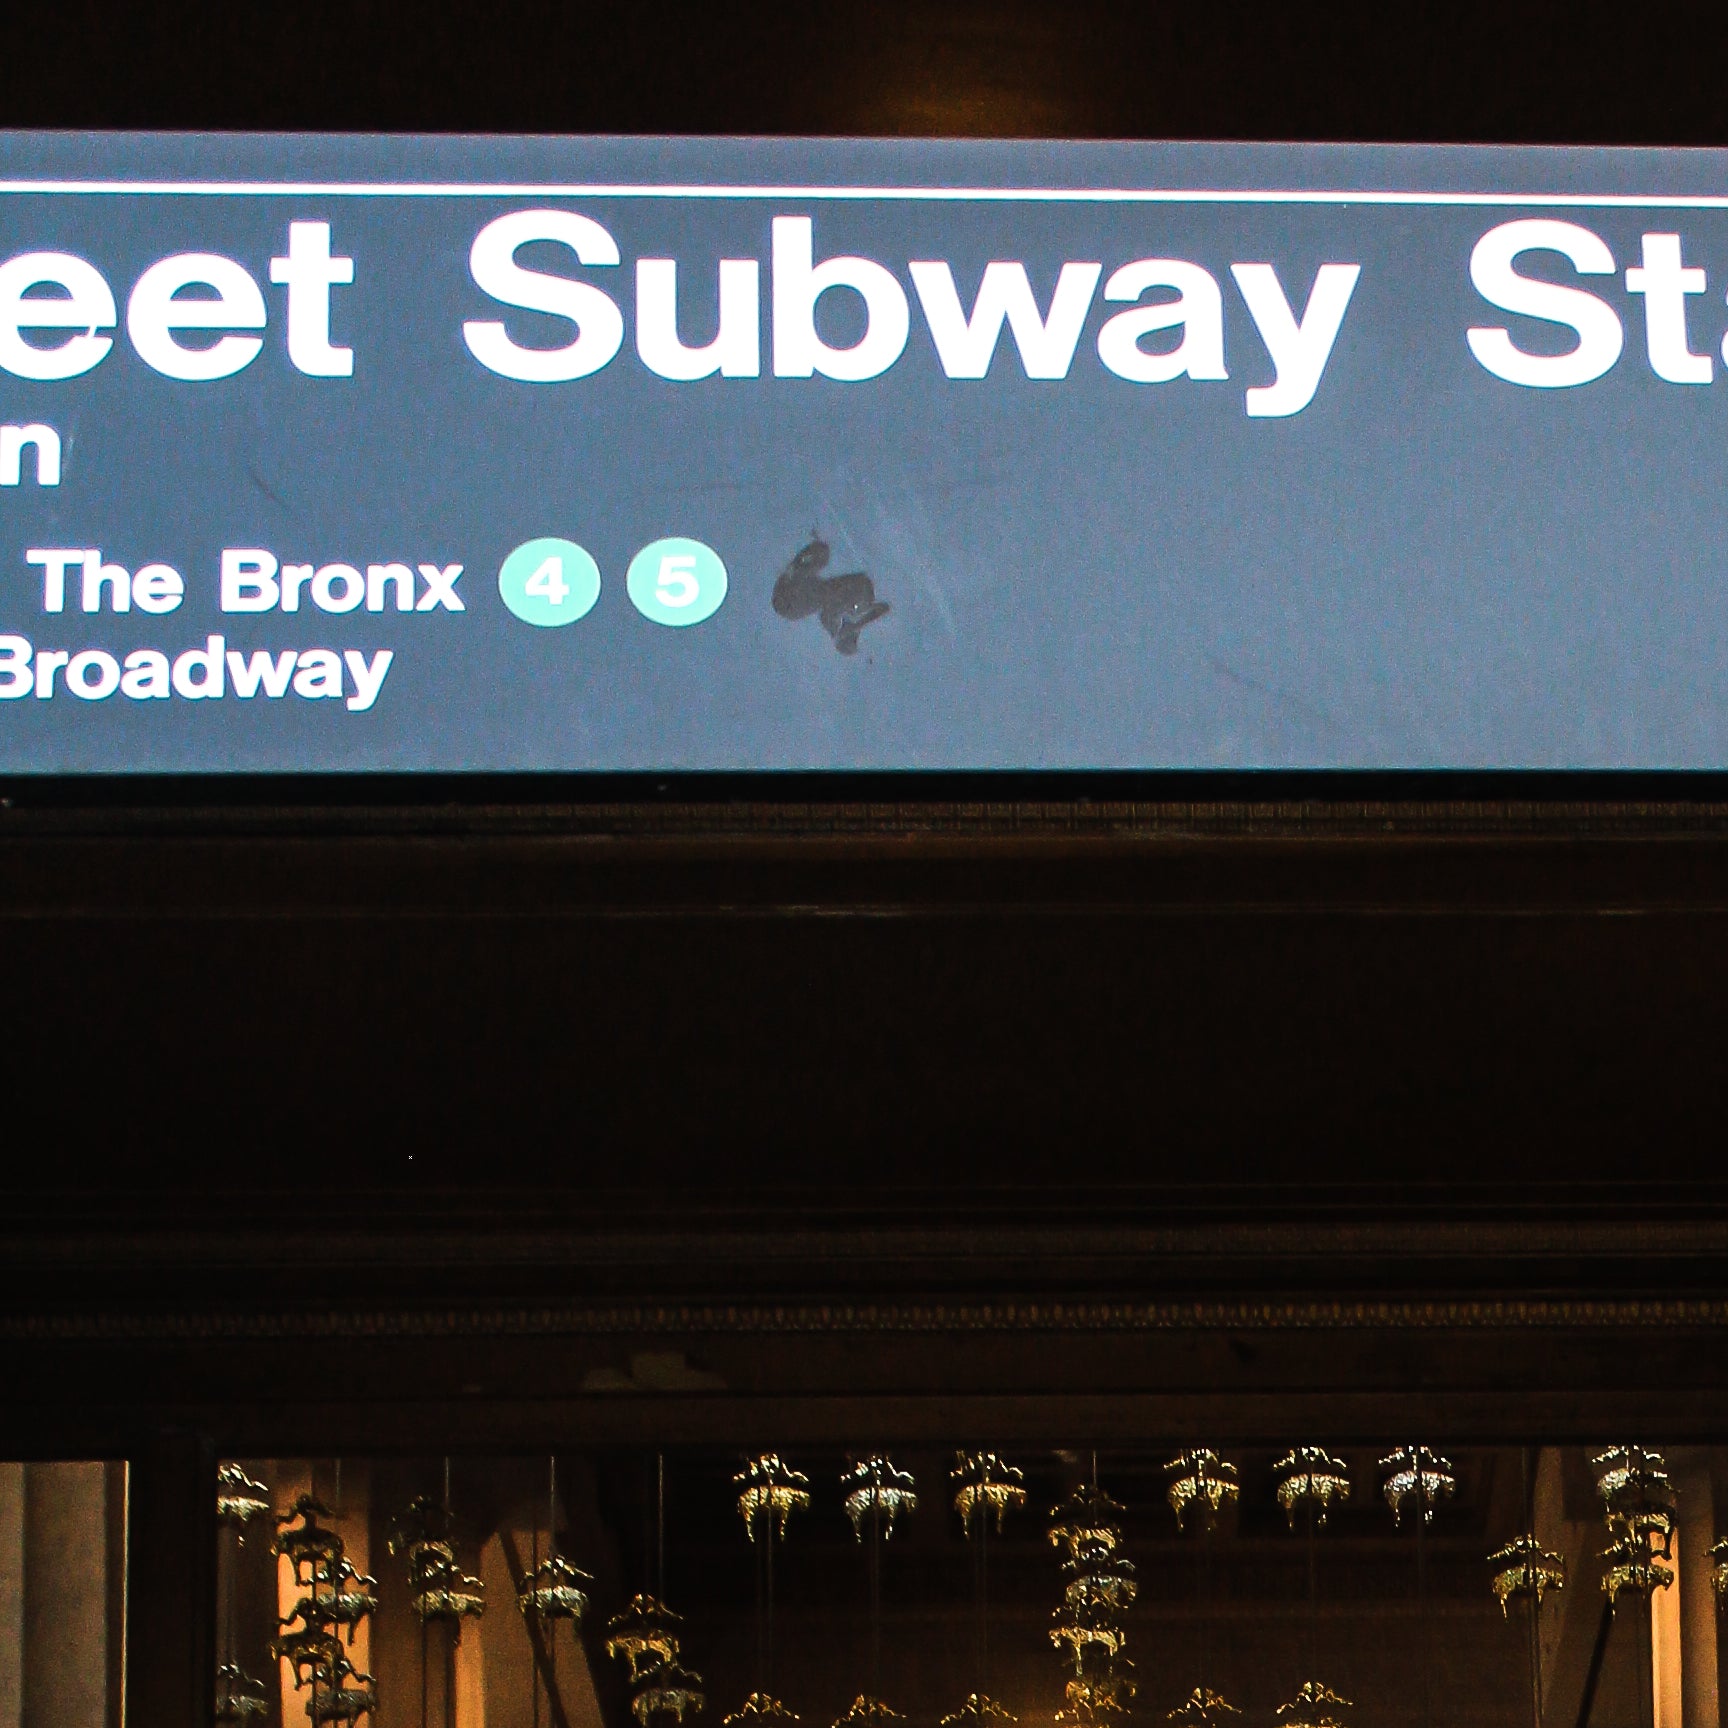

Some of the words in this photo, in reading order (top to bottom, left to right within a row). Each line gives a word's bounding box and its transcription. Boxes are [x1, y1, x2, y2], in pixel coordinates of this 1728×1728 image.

[0, 223, 352, 379] eet
[462, 208, 1362, 418] Subway
[26, 549, 184, 613] The
[221, 549, 465, 612] Bronx
[0, 636, 392, 710] Broadway
